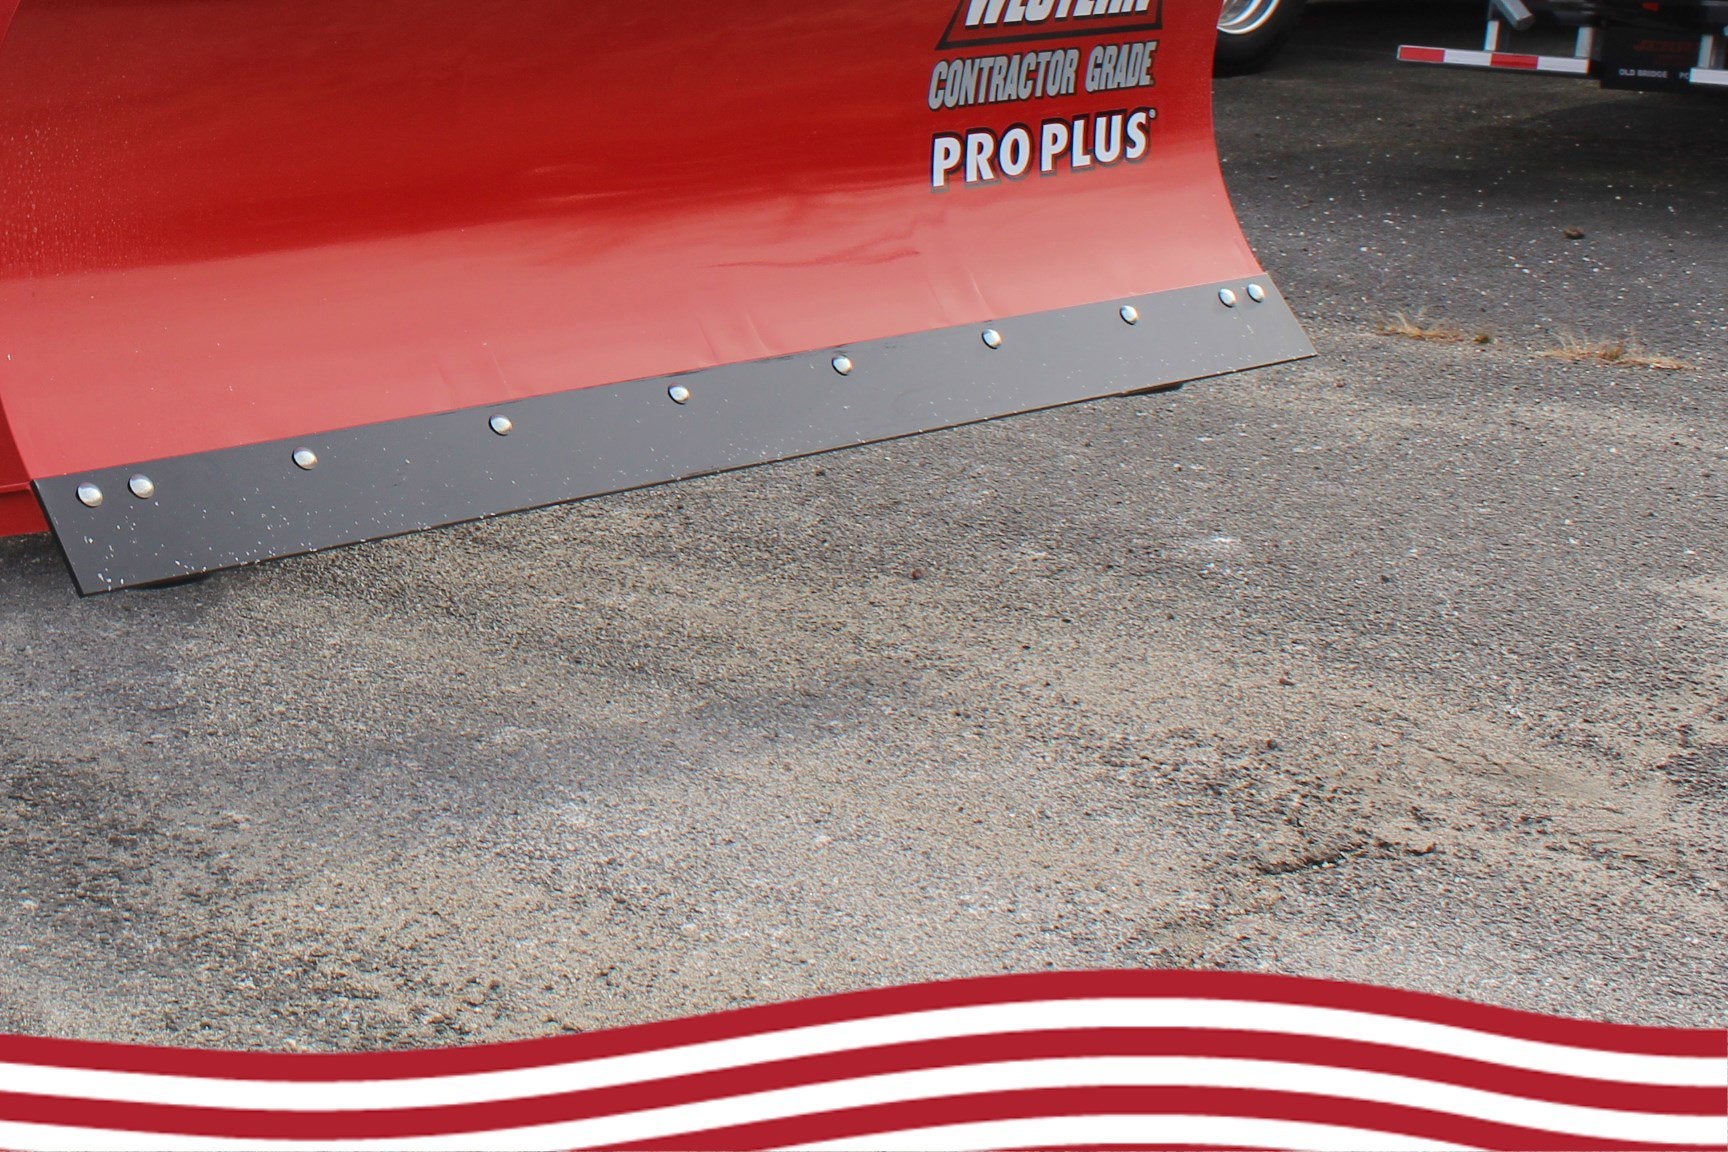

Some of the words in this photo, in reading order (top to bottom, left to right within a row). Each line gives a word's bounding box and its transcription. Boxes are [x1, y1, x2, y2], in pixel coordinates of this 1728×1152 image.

[928, 48, 1081, 111] CONTRACTOR
[1085, 41, 1159, 93] GRADE
[932, 125, 1033, 189] PRO
